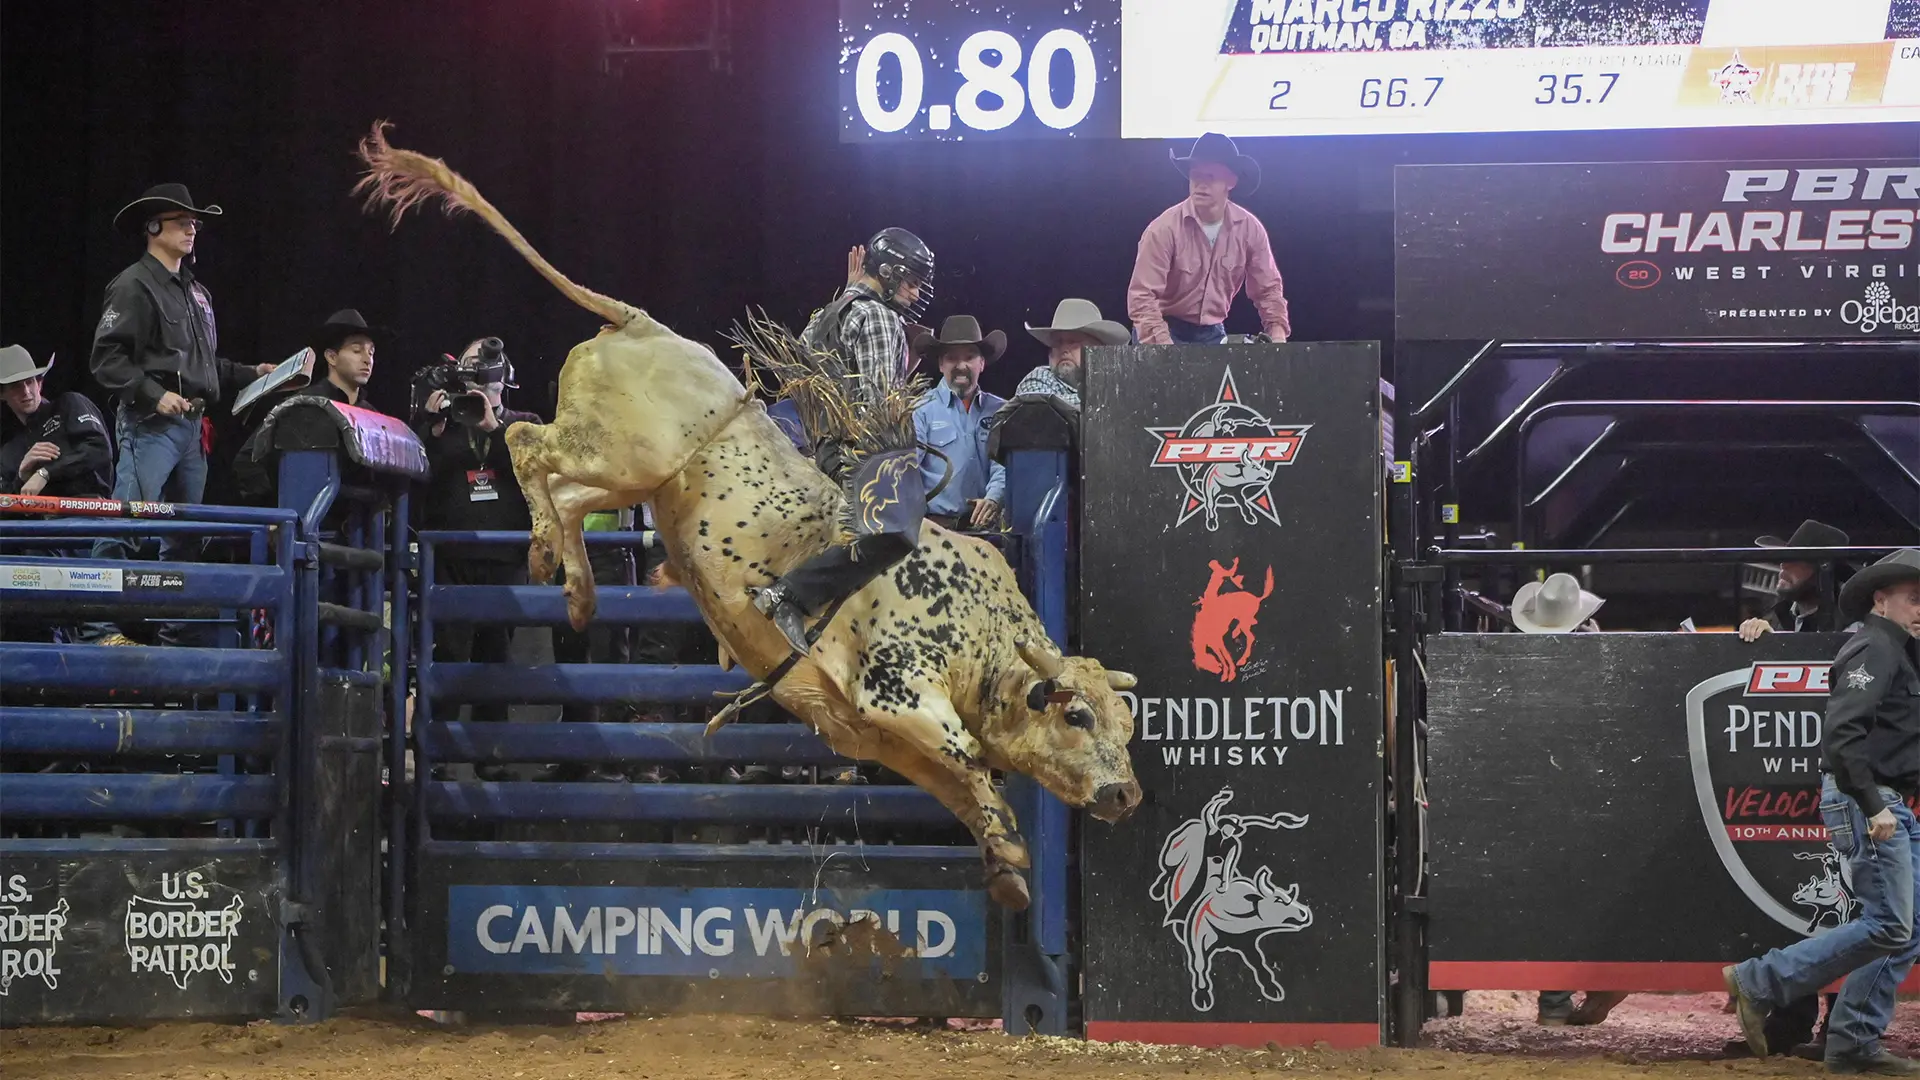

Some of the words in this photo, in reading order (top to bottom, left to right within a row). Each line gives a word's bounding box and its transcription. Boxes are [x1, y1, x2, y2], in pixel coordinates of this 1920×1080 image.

[1251, 21, 1383, 54] QUITMAN,
[856, 29, 1097, 132] 0.80
[1360, 77, 1444, 108] 66.7
[1535, 73, 1620, 104] 35.7
[1269, 81, 1292, 110] 2
[1722, 167, 1920, 202] PBR
[1601, 209, 1920, 253] CHARLES
[1628, 270, 1649, 280] 20
[1674, 265, 1771, 281] WEST
[1800, 263, 1920, 279] VIRGI
[1719, 308, 1807, 318] PRESENTED
[1814, 308, 1832, 317] BY
[1840, 298, 1920, 333] Ogleba
[1164, 442, 1291, 459] PBR
[60, 500, 122, 511] PBRSHOP.COM
[130, 502, 175, 515] BEATBOX
[69, 571, 101, 580] Walmart
[1724, 704, 1827, 752] PEND
[1162, 746, 1289, 765] WHISKY
[1735, 827, 1771, 839] 10TH
[162, 871, 209, 899] U.S.
[130, 911, 239, 939] BORDER
[476, 904, 735, 957] CAMPING
[131, 943, 236, 973] PATROL
